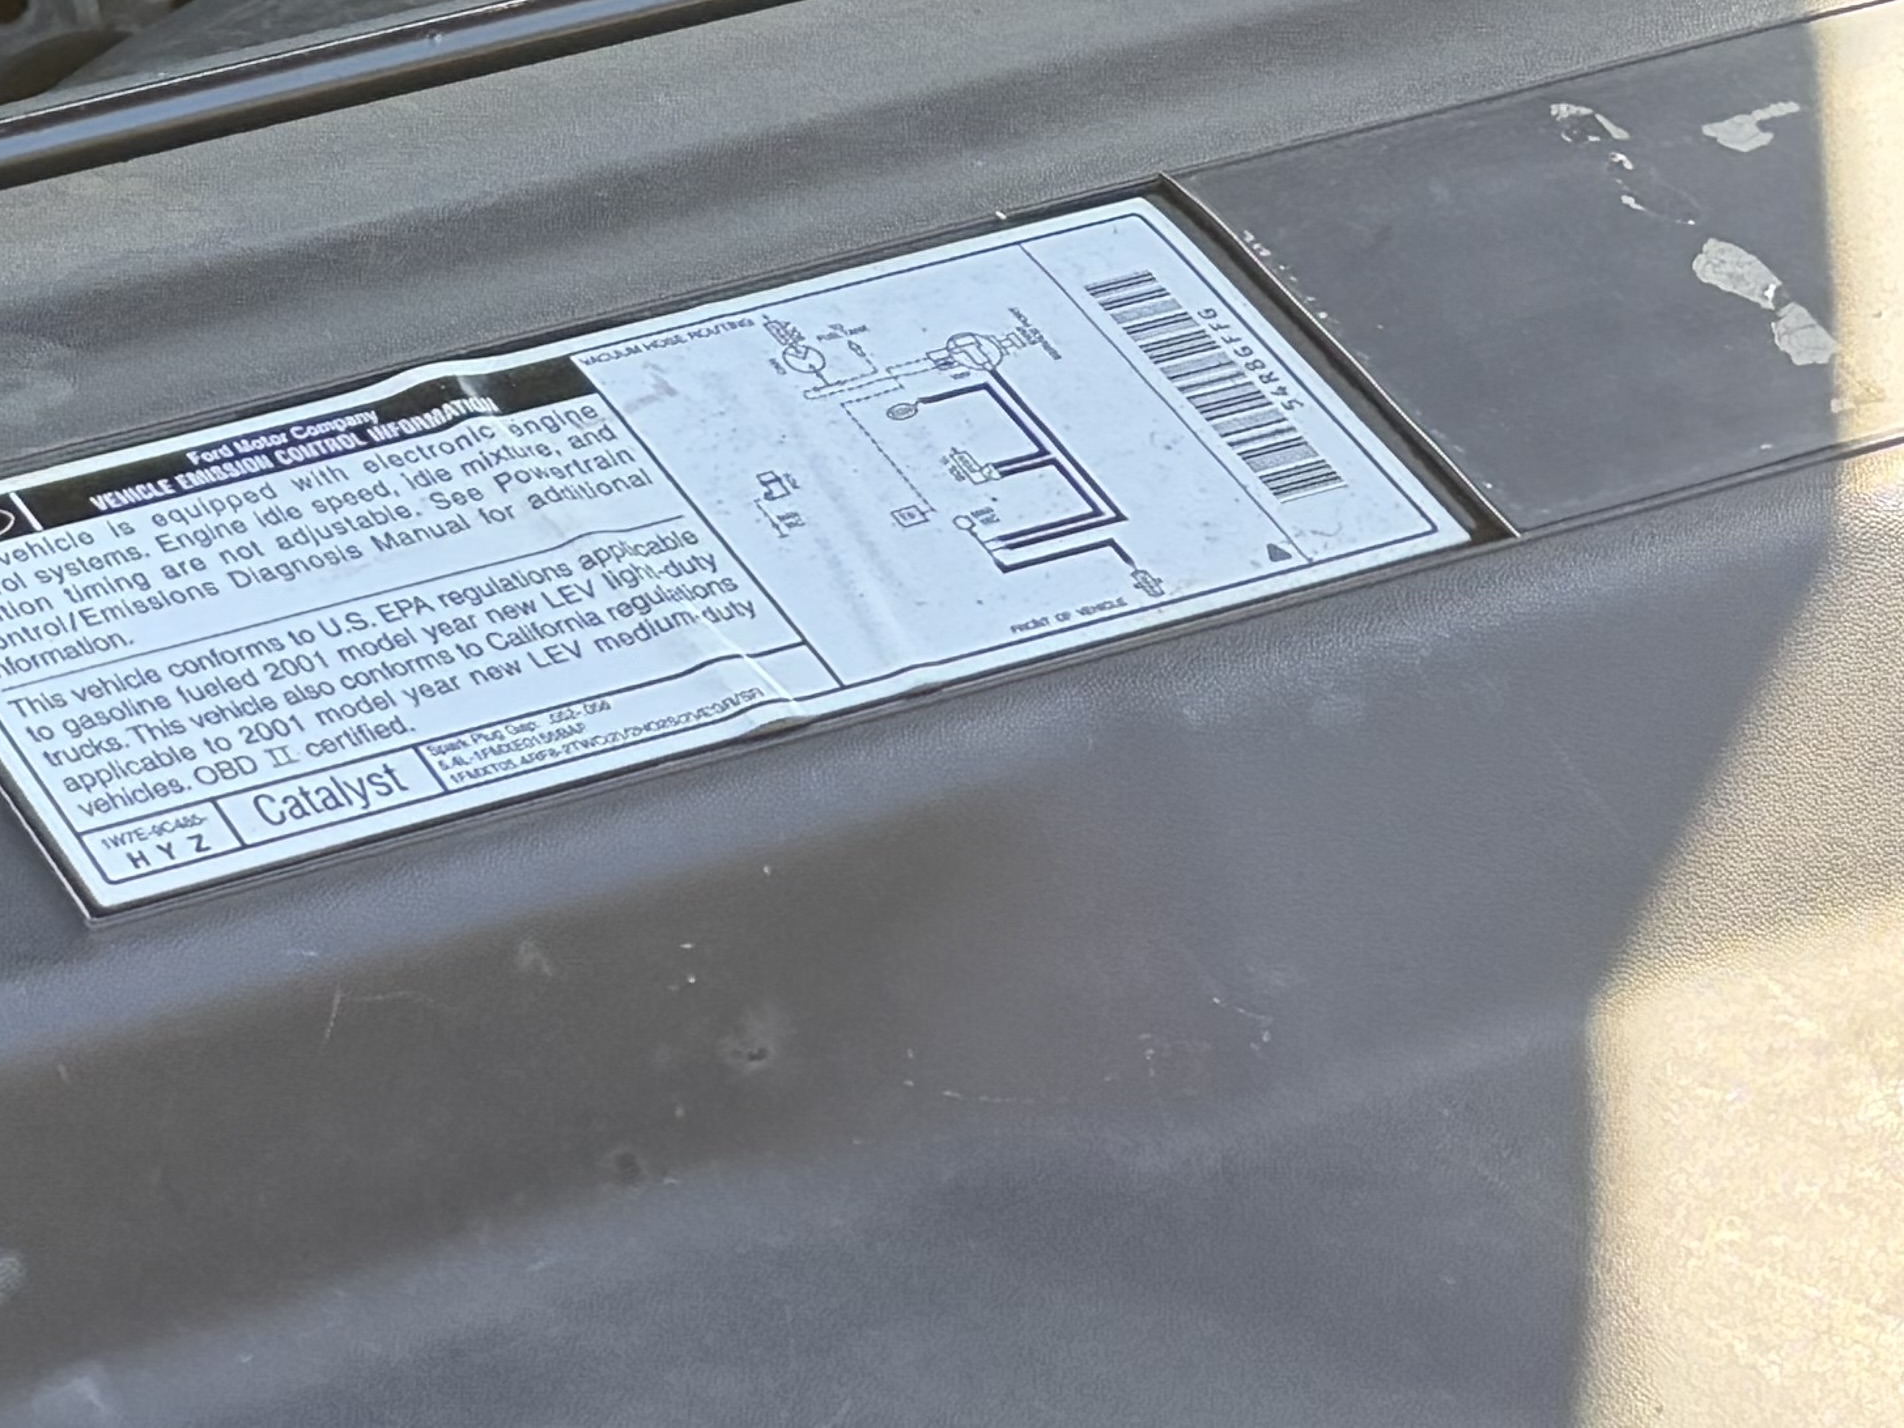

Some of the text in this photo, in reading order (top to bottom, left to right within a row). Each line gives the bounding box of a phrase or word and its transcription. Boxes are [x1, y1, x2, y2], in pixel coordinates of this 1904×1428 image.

[578, 343, 643, 366] VACUUM
[640, 333, 688, 351] HOSE
[685, 317, 755, 340] ROUTING
[1195, 306, 1305, 411] 54R8GFFG
[88, 391, 500, 511] VEHICLE EMISSION CONTROL INFORMATION
[105, 519, 136, 539] is
[150, 480, 278, 528] equipped
[289, 464, 350, 493] with
[361, 424, 496, 474] electronic
[506, 404, 606, 438] engine
[184, 409, 379, 466] Ford Motor Company
[32, 545, 151, 586] systems.
[153, 518, 249, 554] Engine
[251, 504, 303, 528] idle
[310, 478, 401, 515] speed,
[398, 466, 453, 490] idle
[458, 442, 562, 477] mixture,
[566, 422, 618, 450] and
[61, 571, 152, 604] timing
[159, 556, 208, 580] are
[217, 539, 266, 565] not
[274, 503, 423, 551] adjustable.
[427, 486, 485, 511] See
[491, 448, 636, 494] Powertrain
[225, 543, 364, 589] Diagnosis
[368, 512, 472, 553] Manual
[476, 503, 515, 525] for
[526, 466, 654, 511] additional
[5, 529, 700, 718] This vehicle conforms to U.S. EPA regulations applicable
[24, 552, 718, 743] to gasoline fueled 2001 model year new LEV light-duty
[41, 566, 739, 768] trucks. This vehicle also conforms to California regulations
[61, 599, 757, 794] applicable to 2001 model year new LEV medium-duty
[76, 713, 416, 817] vehicles. OBD II certified.
[251, 762, 409, 826] Catalyst
[125, 832, 212, 869] H Y Z
